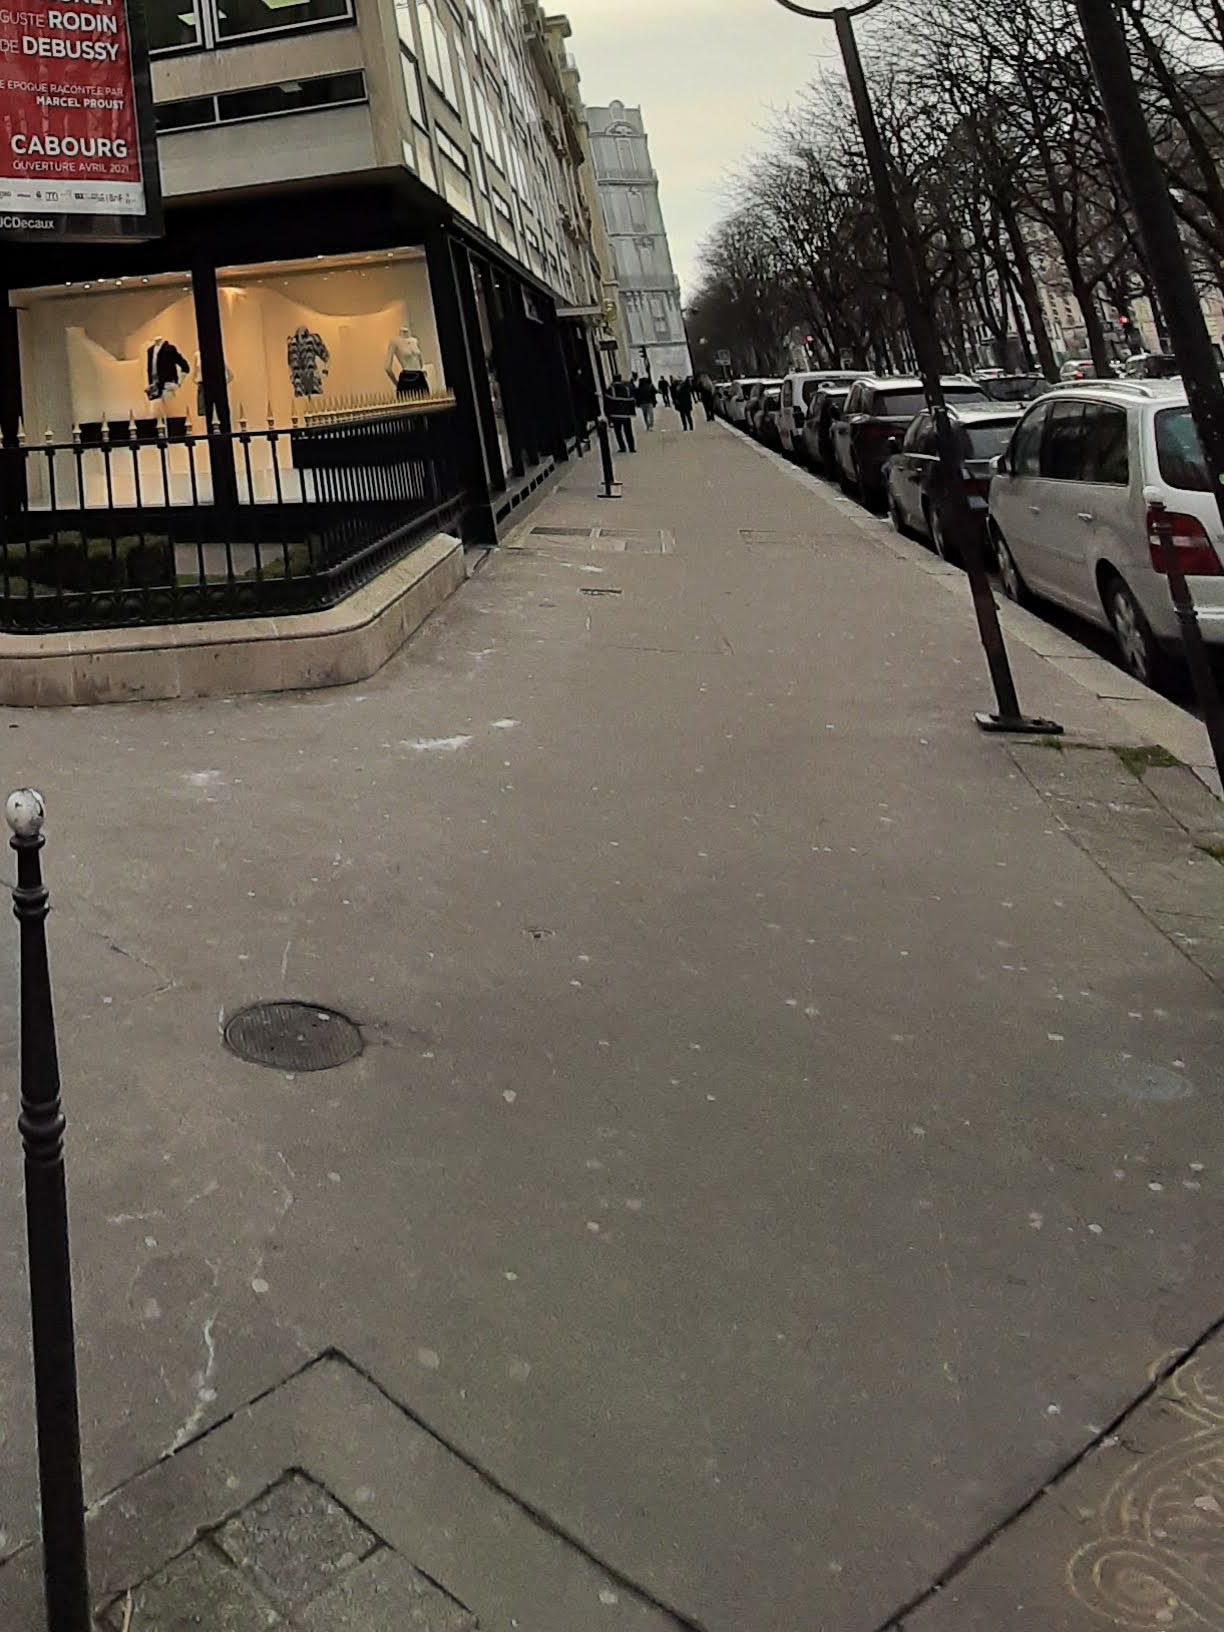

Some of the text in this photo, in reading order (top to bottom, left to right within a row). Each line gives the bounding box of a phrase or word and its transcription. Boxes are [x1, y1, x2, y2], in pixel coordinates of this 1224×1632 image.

[48, 10, 117, 33] RODIN
[22, 35, 119, 61] DEBUSSY
[105, 86, 124, 96] PAR
[36, 95, 124, 110] MARCEL PROUST
[11, 134, 128, 158] CABOURG
[13, 160, 76, 172] OUVERTURE
[78, 162, 107, 173] AVRIL
